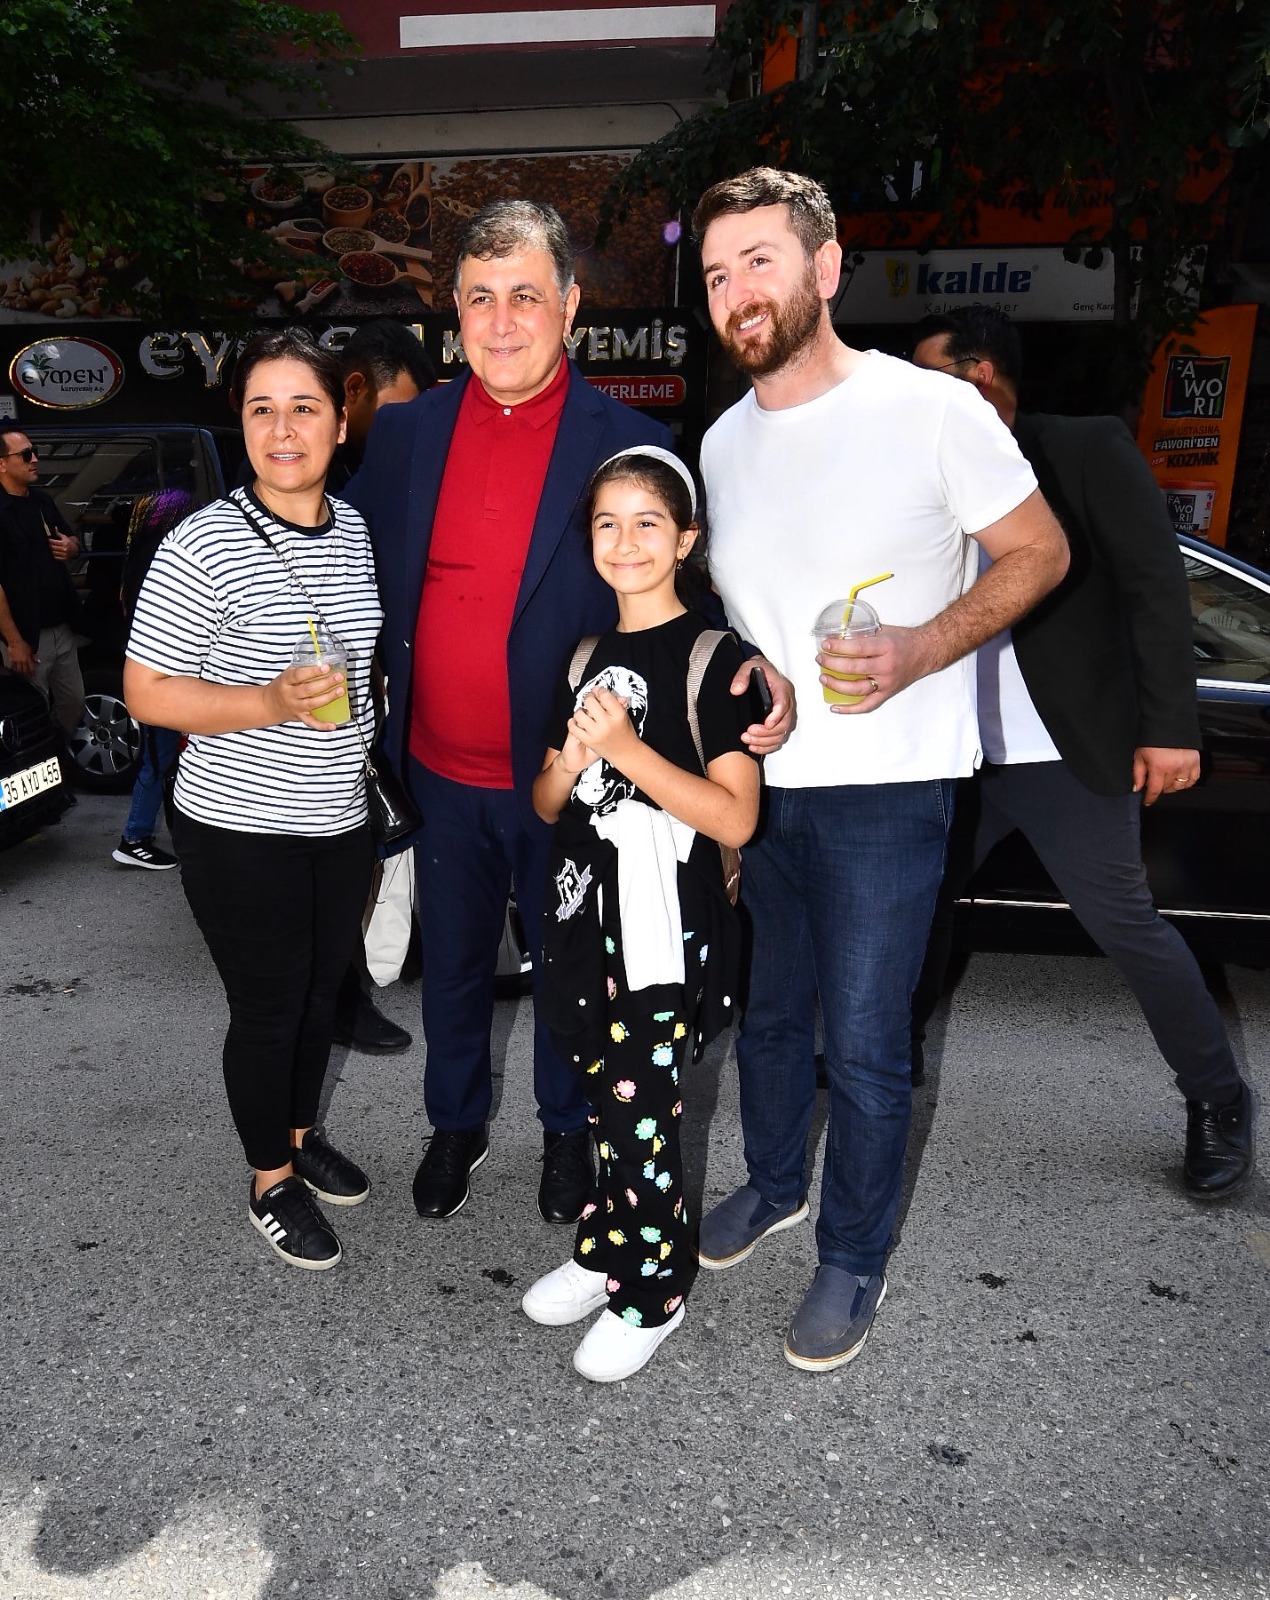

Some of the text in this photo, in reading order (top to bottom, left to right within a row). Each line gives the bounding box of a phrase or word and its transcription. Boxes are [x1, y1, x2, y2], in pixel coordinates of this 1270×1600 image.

[917, 262, 1032, 295] kalde
[1184, 378, 1223, 398] WO
[1193, 397, 1215, 416] RI
[1154, 436, 1219, 451] FAWORİ'DEN
[1174, 504, 1194, 514] WO
[4, 780, 19, 803] 35
[41, 762, 60, 785] 455
